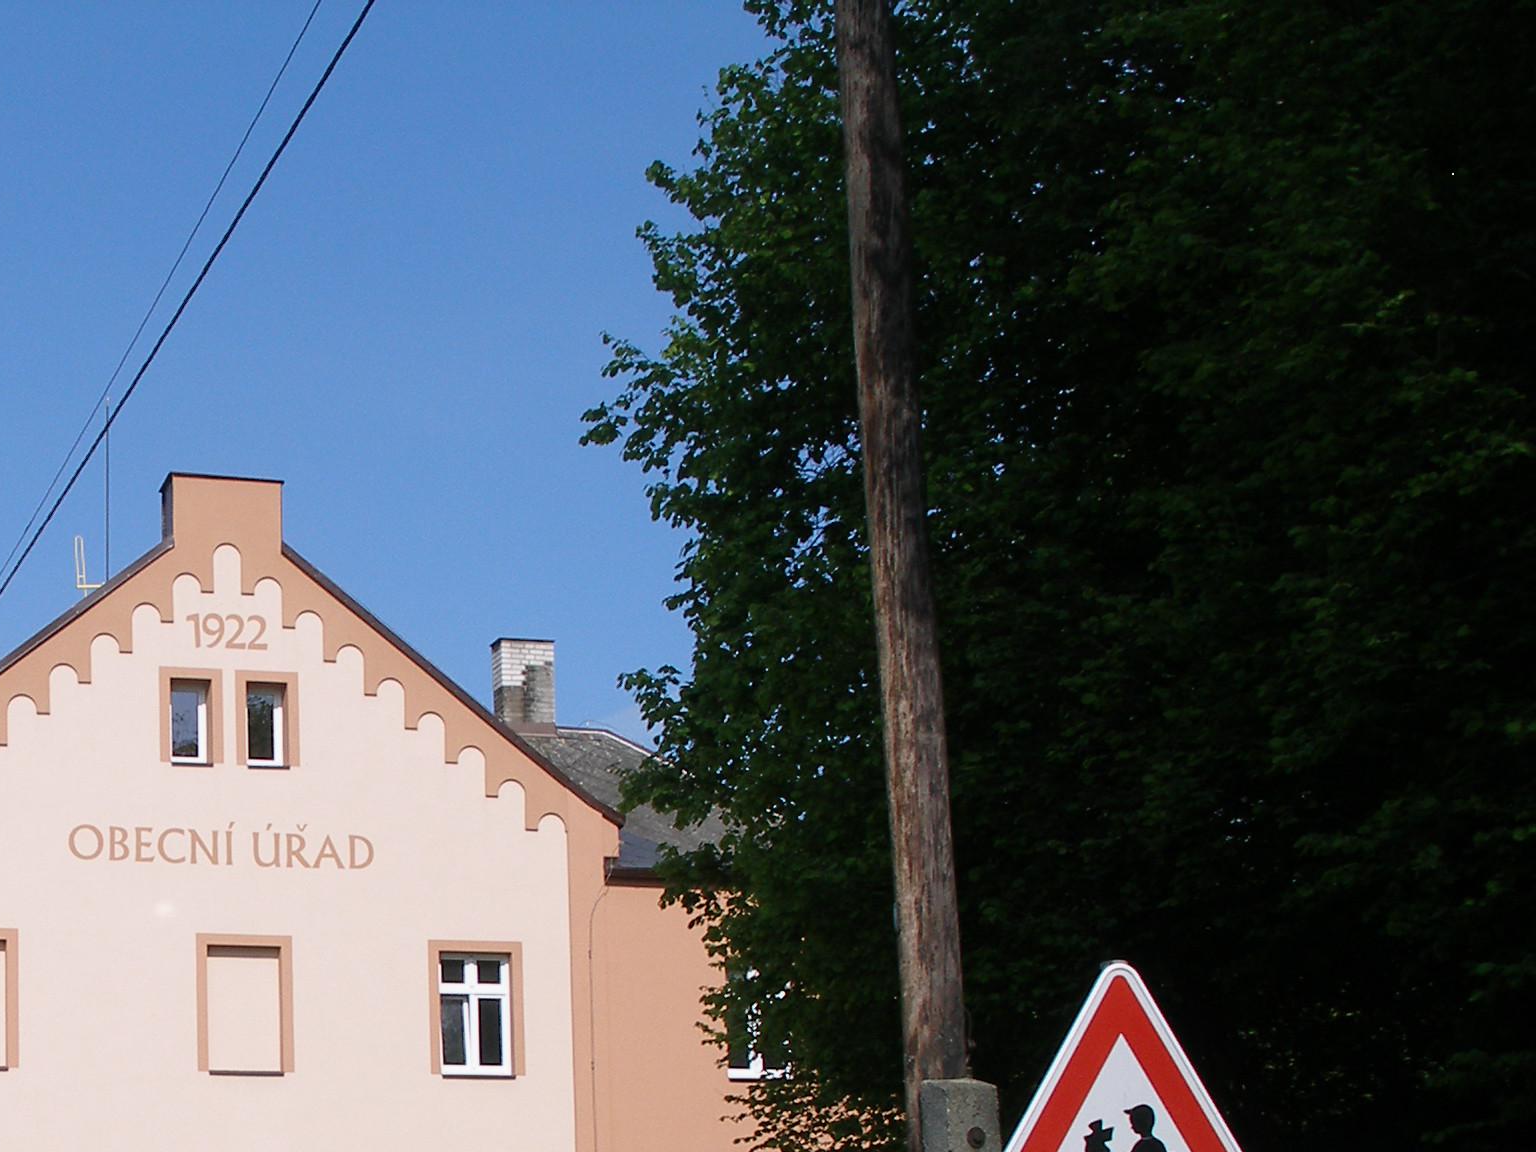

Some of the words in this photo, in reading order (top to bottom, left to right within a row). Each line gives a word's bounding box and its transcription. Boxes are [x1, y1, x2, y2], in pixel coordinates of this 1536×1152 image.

[185, 612, 269, 651] 1922
[68, 821, 236, 866] OBECNÍ
[252, 823, 375, 870] ÚŘAD
